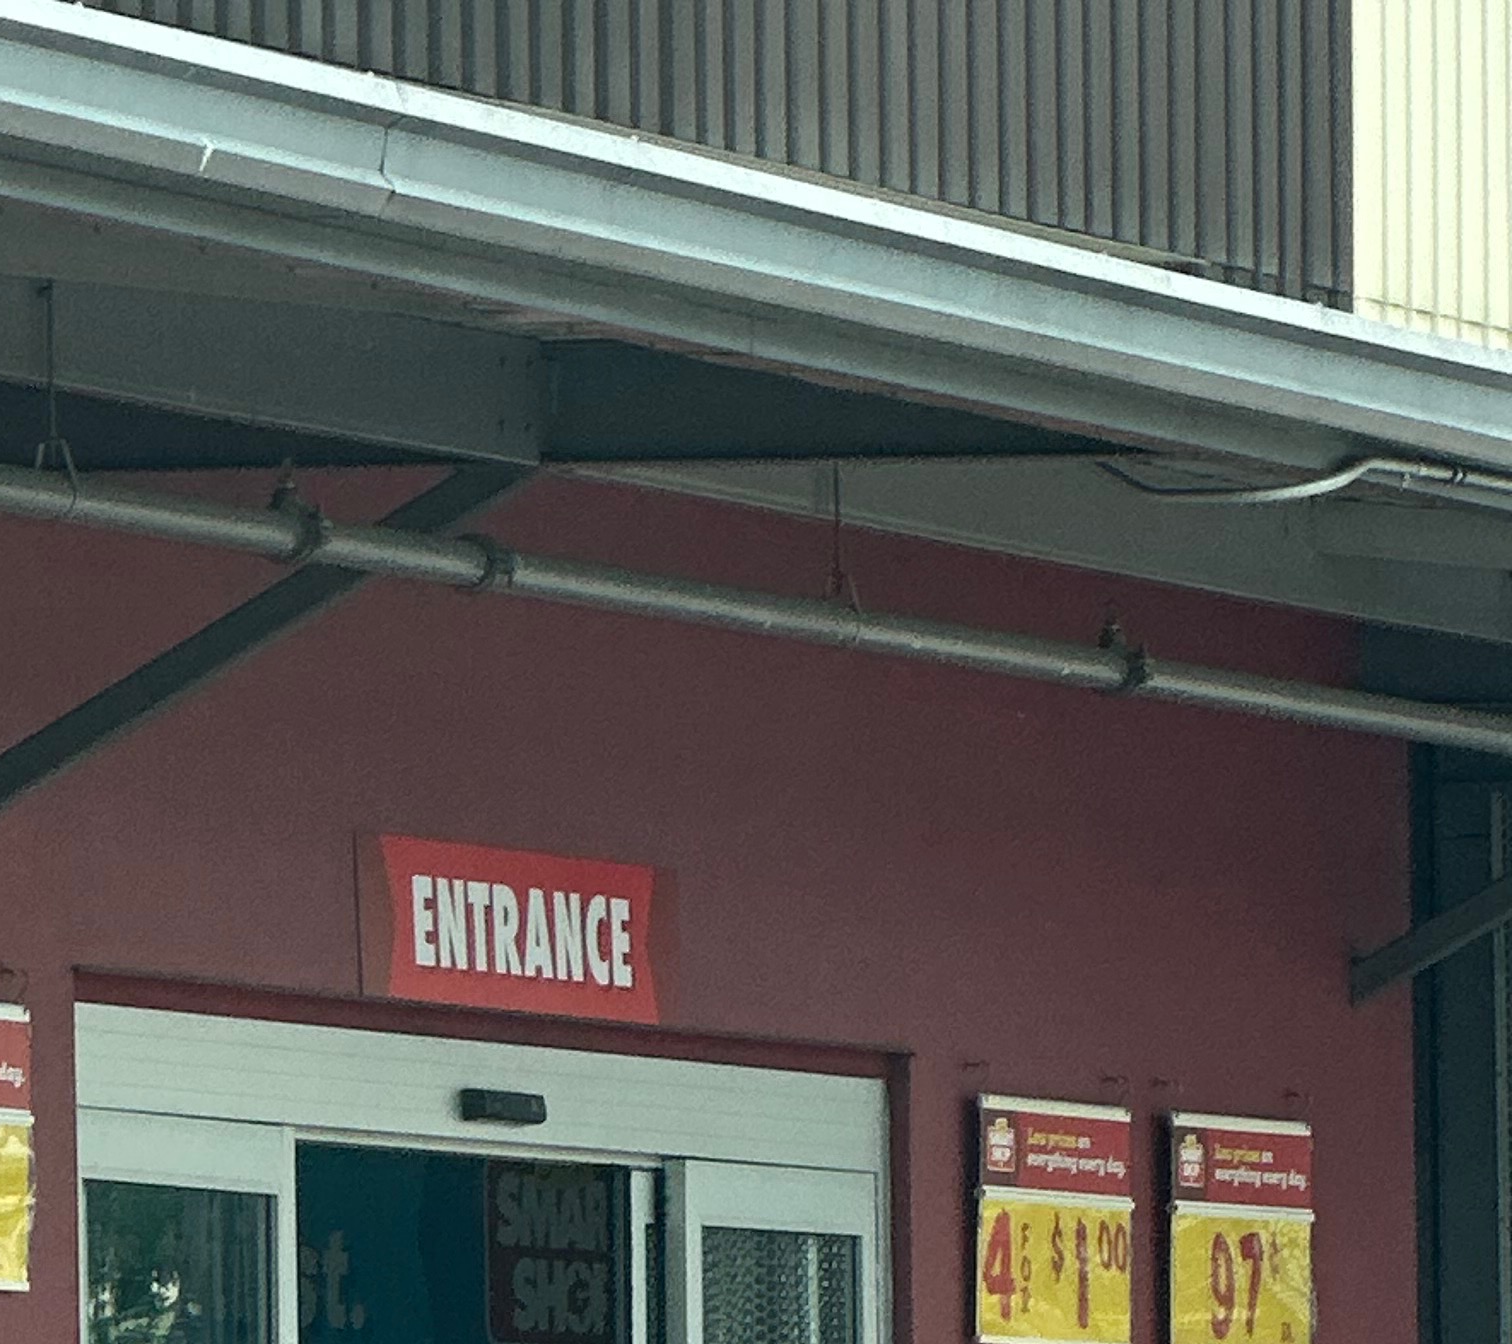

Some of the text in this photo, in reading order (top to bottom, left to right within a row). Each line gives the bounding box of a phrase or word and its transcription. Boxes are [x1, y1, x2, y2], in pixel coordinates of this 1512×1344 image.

[411, 873, 634, 988] ENTRANCE
[495, 1170, 607, 1250] SMAR
[985, 1207, 1016, 1322] 4
